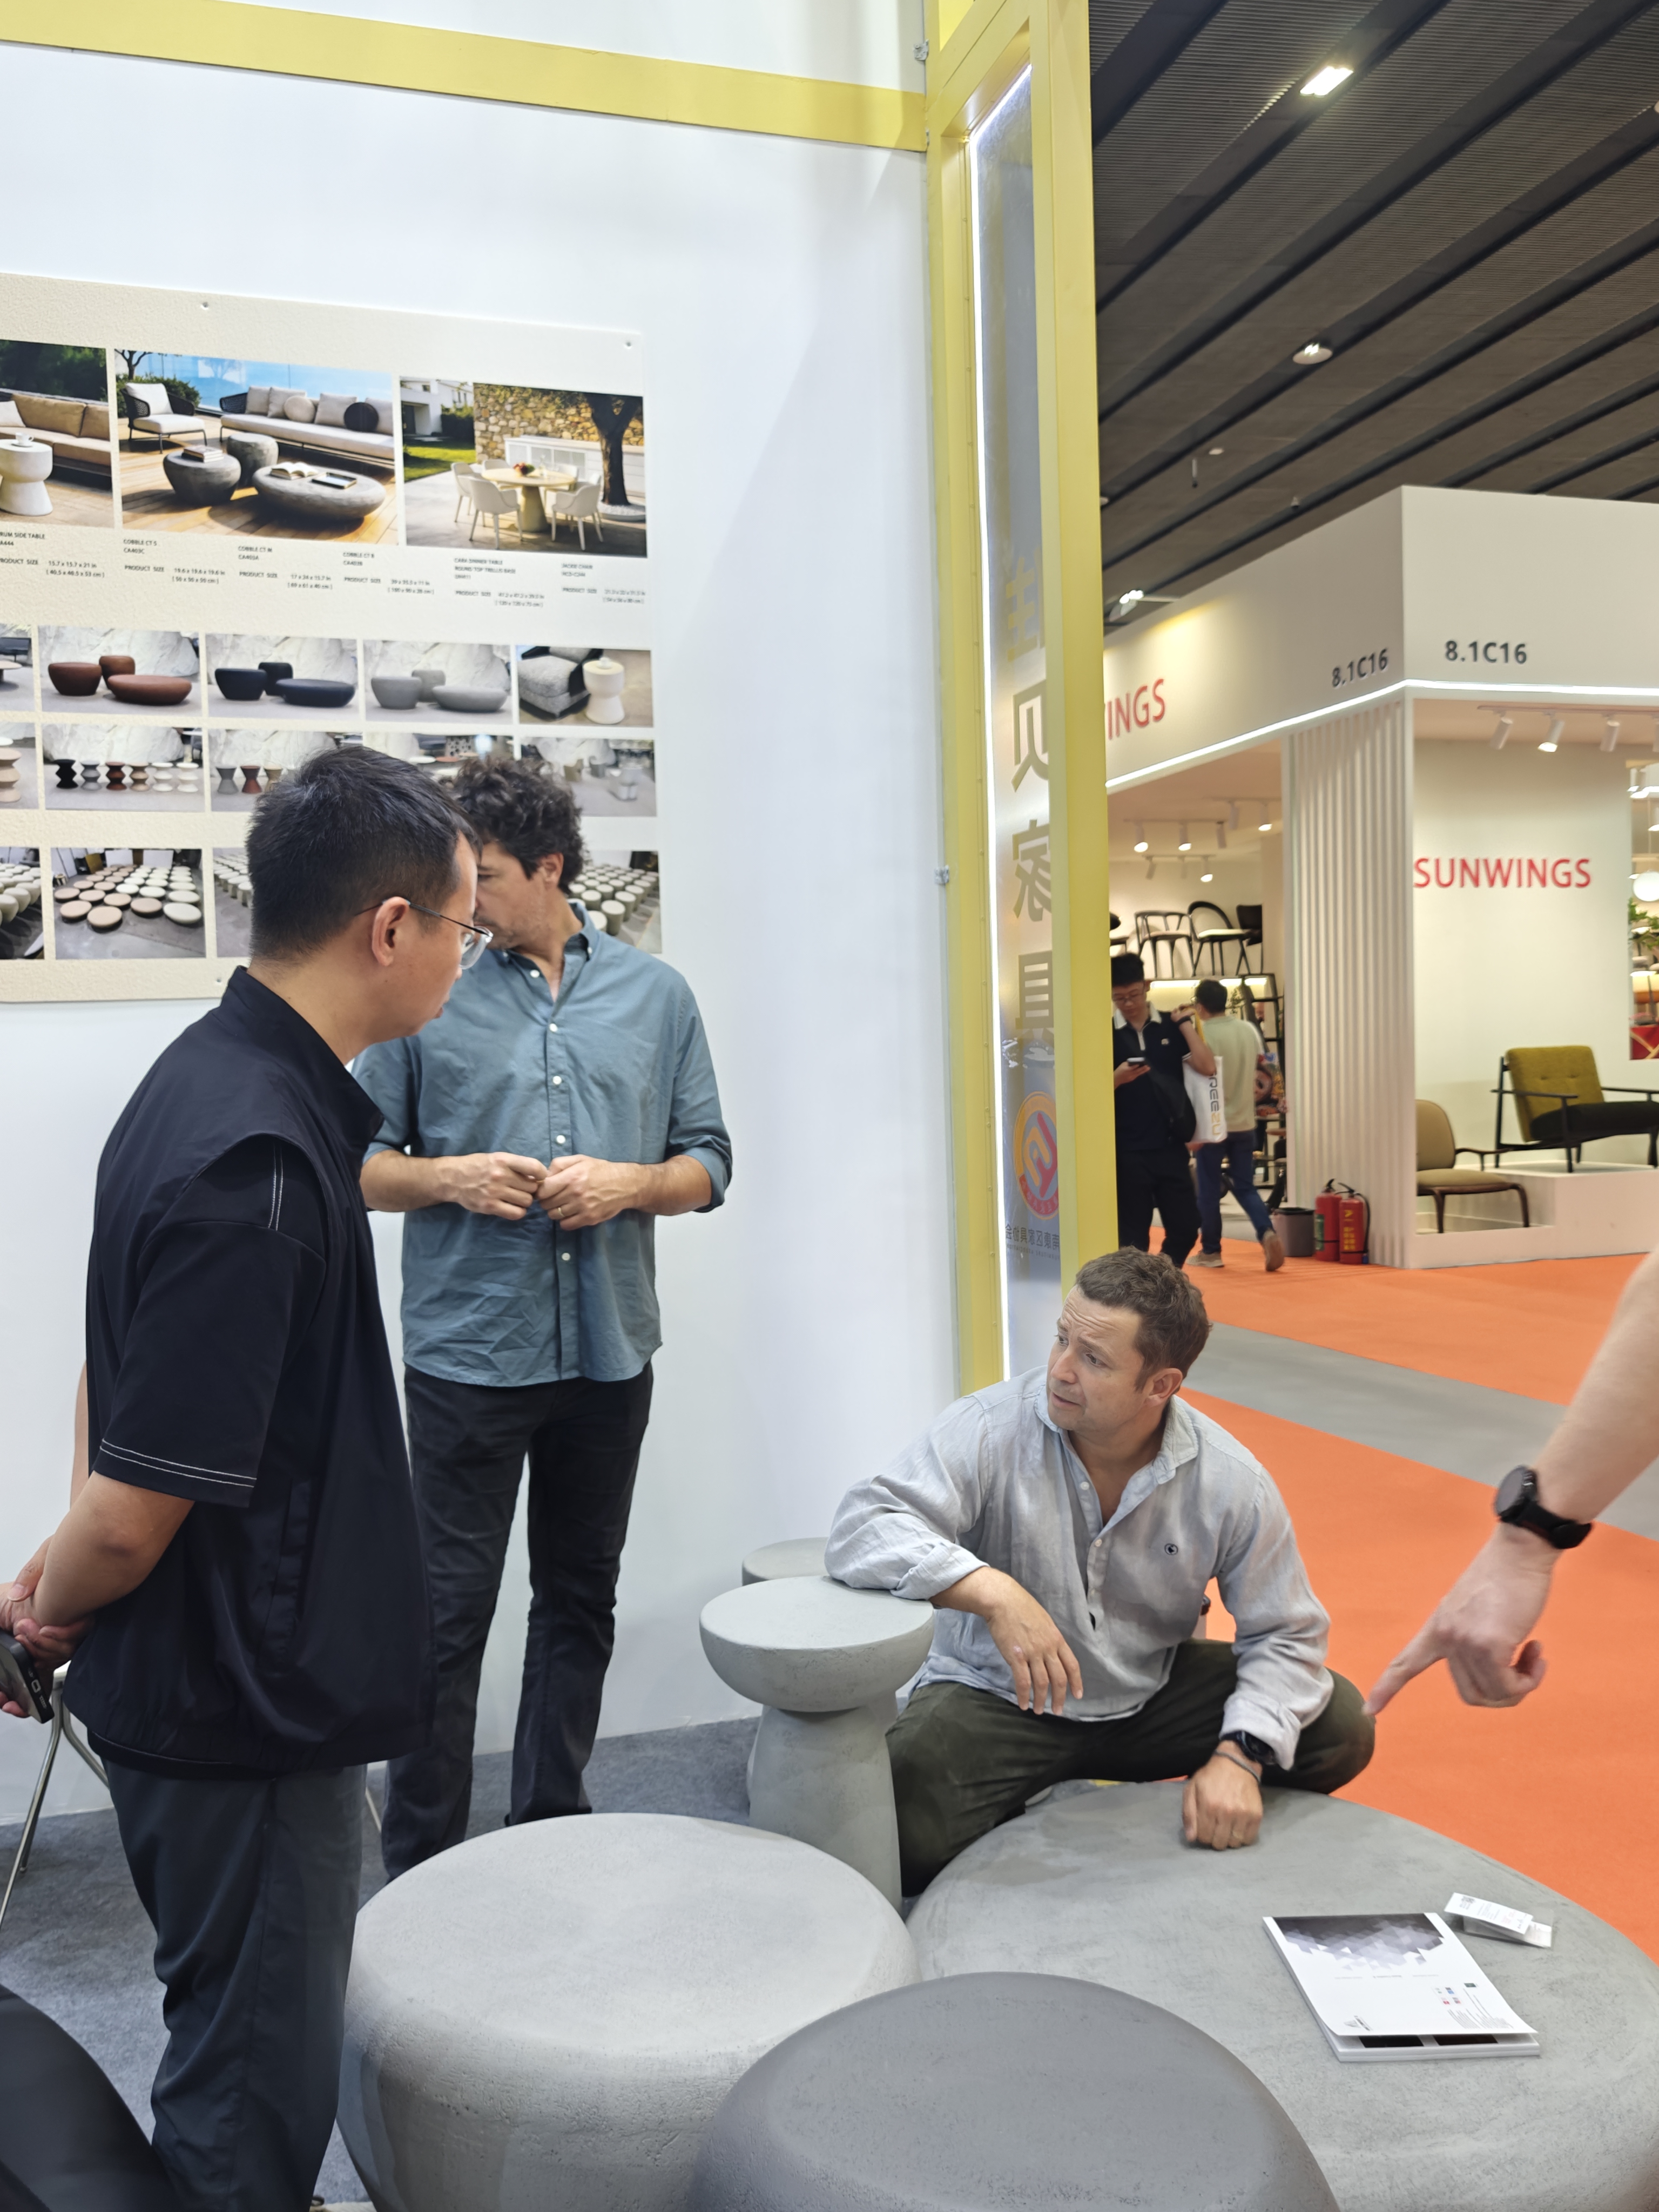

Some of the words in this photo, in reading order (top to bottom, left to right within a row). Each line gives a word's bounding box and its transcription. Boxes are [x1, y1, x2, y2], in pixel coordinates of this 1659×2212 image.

[1332, 648, 1388, 687] 8.1C16
[1446, 640, 1527, 665] 8.1C16
[1105, 678, 1165, 740] INGS
[1414, 858, 1590, 888] SUNWINGS
[1209, 1073, 1221, 1136] REEZU
